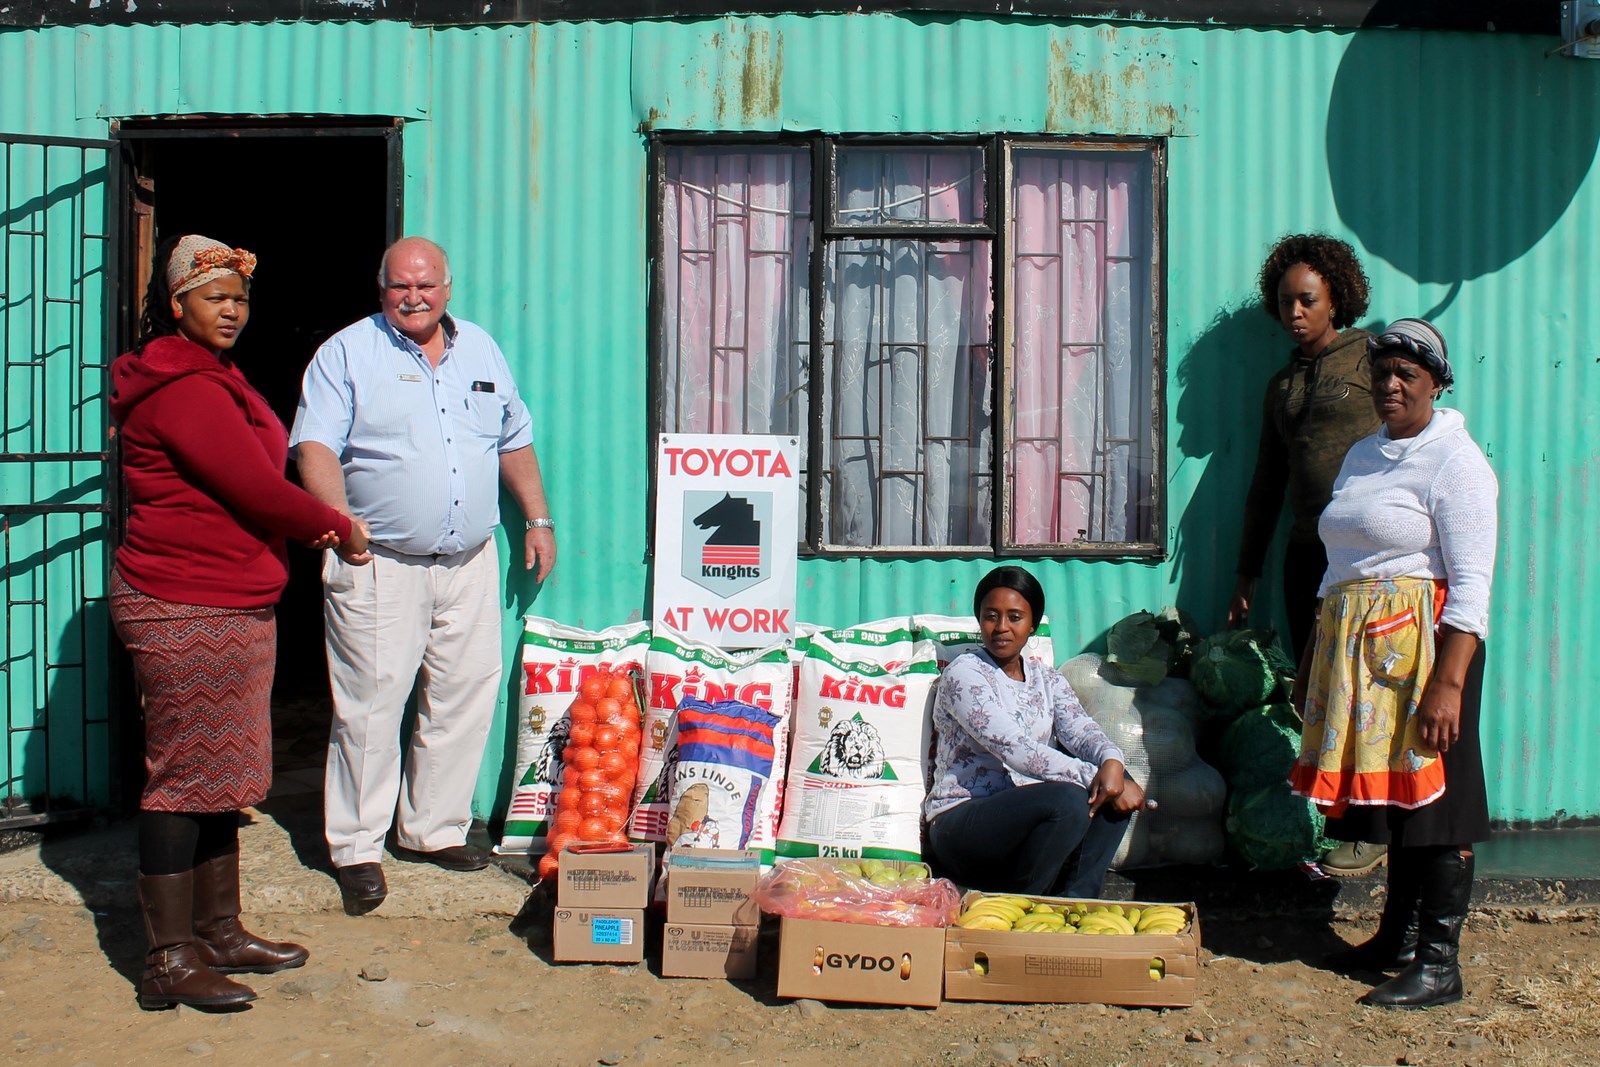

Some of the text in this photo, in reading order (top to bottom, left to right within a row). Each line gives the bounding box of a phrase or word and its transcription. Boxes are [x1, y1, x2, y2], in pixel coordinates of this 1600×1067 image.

[664, 448, 792, 477] TOYOTA
[702, 565, 760, 580] Knights
[663, 607, 790, 633] AT WORK
[702, 768, 741, 801] LINDE
[822, 845, 839, 859] 25
[594, 924, 620, 932] PINEAPPLE
[826, 953, 895, 972] GYDO
